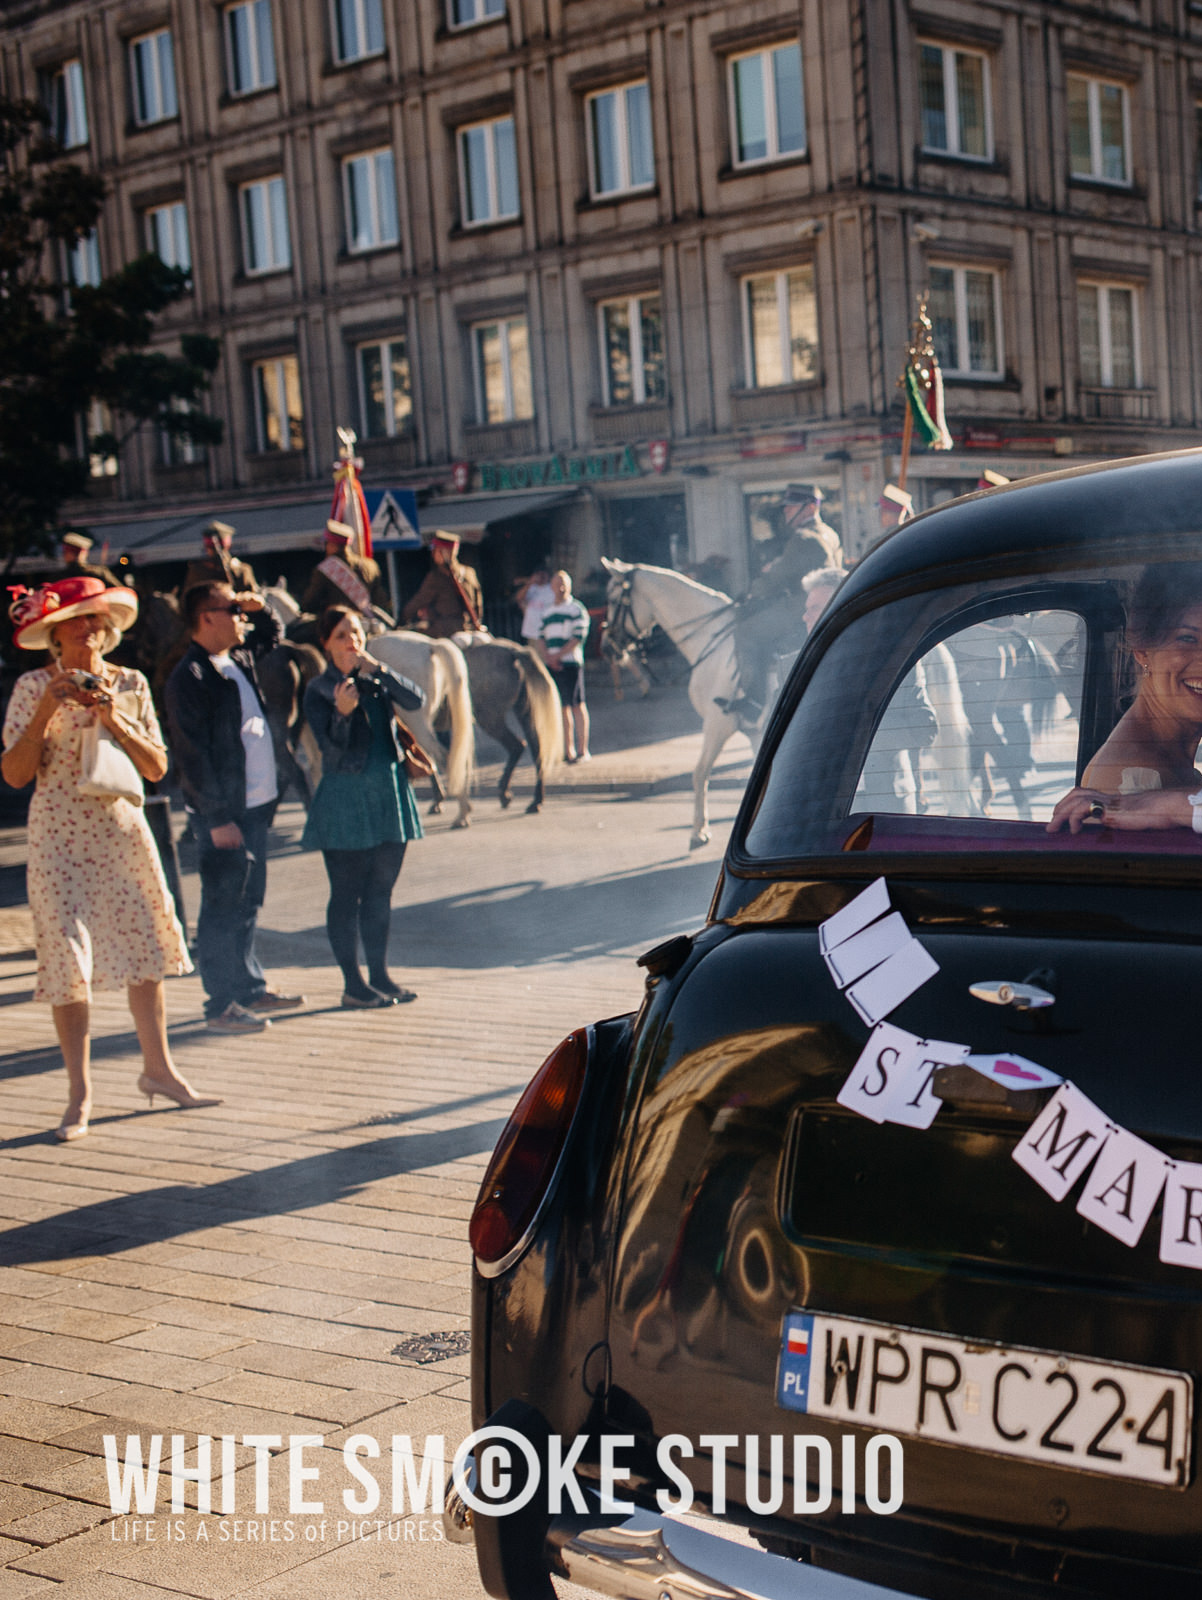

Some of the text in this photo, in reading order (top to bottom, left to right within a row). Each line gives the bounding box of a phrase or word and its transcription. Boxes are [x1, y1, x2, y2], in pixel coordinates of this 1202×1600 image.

[783, 1371, 806, 1396] PL
[823, 1329, 1176, 1471] WPR C224
